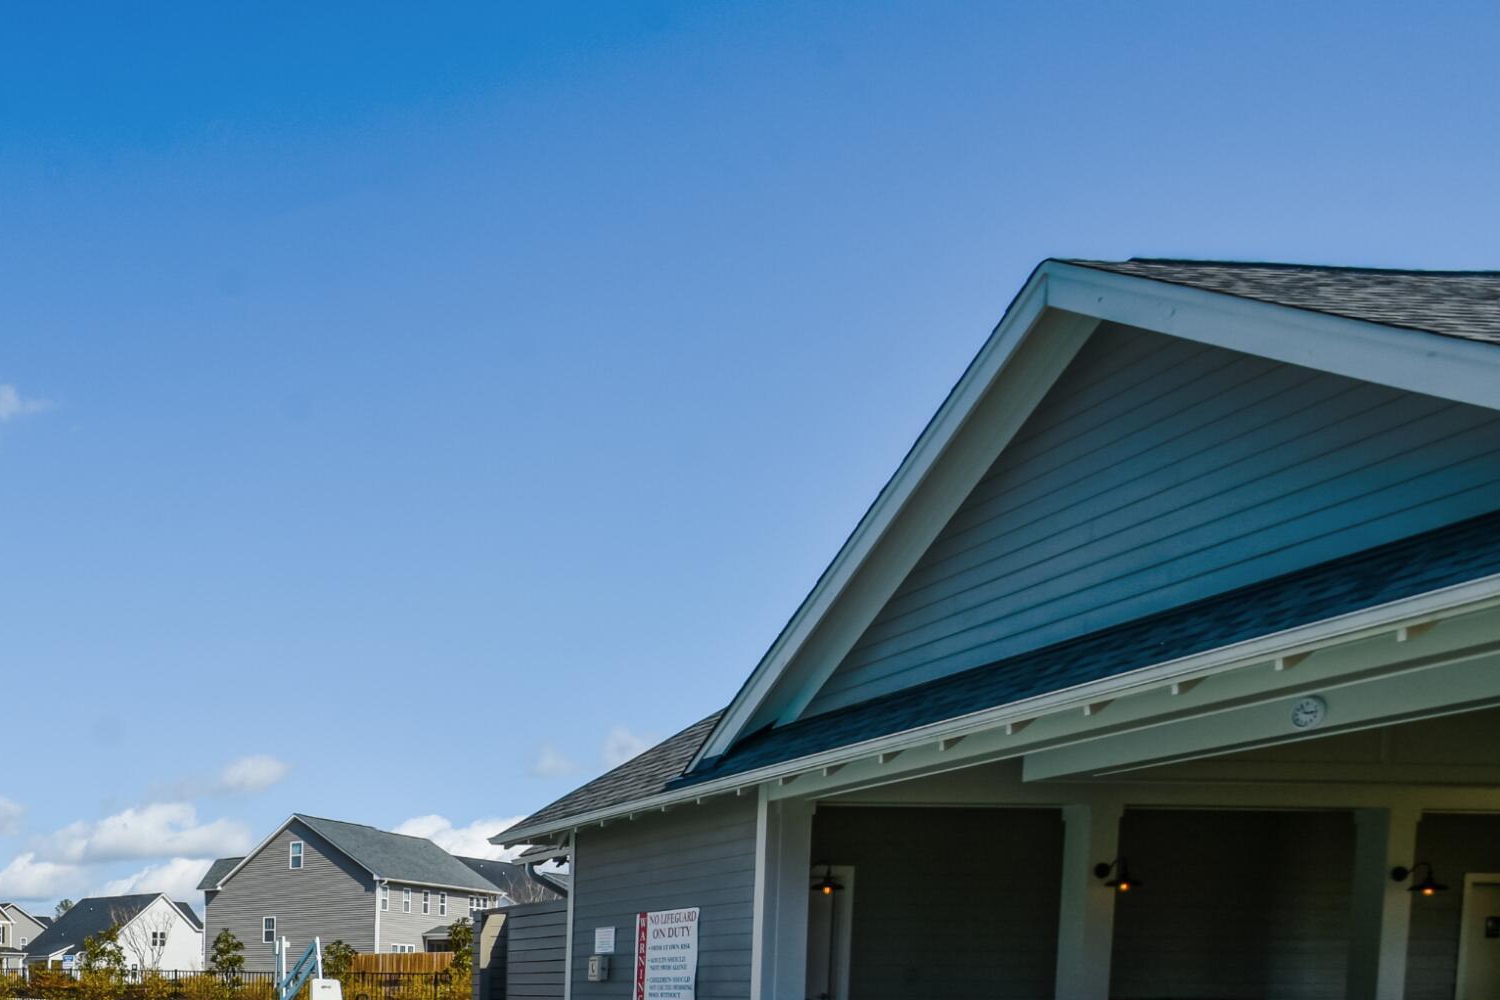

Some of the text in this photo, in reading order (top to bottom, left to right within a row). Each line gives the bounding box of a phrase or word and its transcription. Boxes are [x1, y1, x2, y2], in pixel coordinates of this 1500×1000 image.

[650, 911, 697, 925] NO LIFEGUARD
[652, 926, 691, 939] ON DUTY
